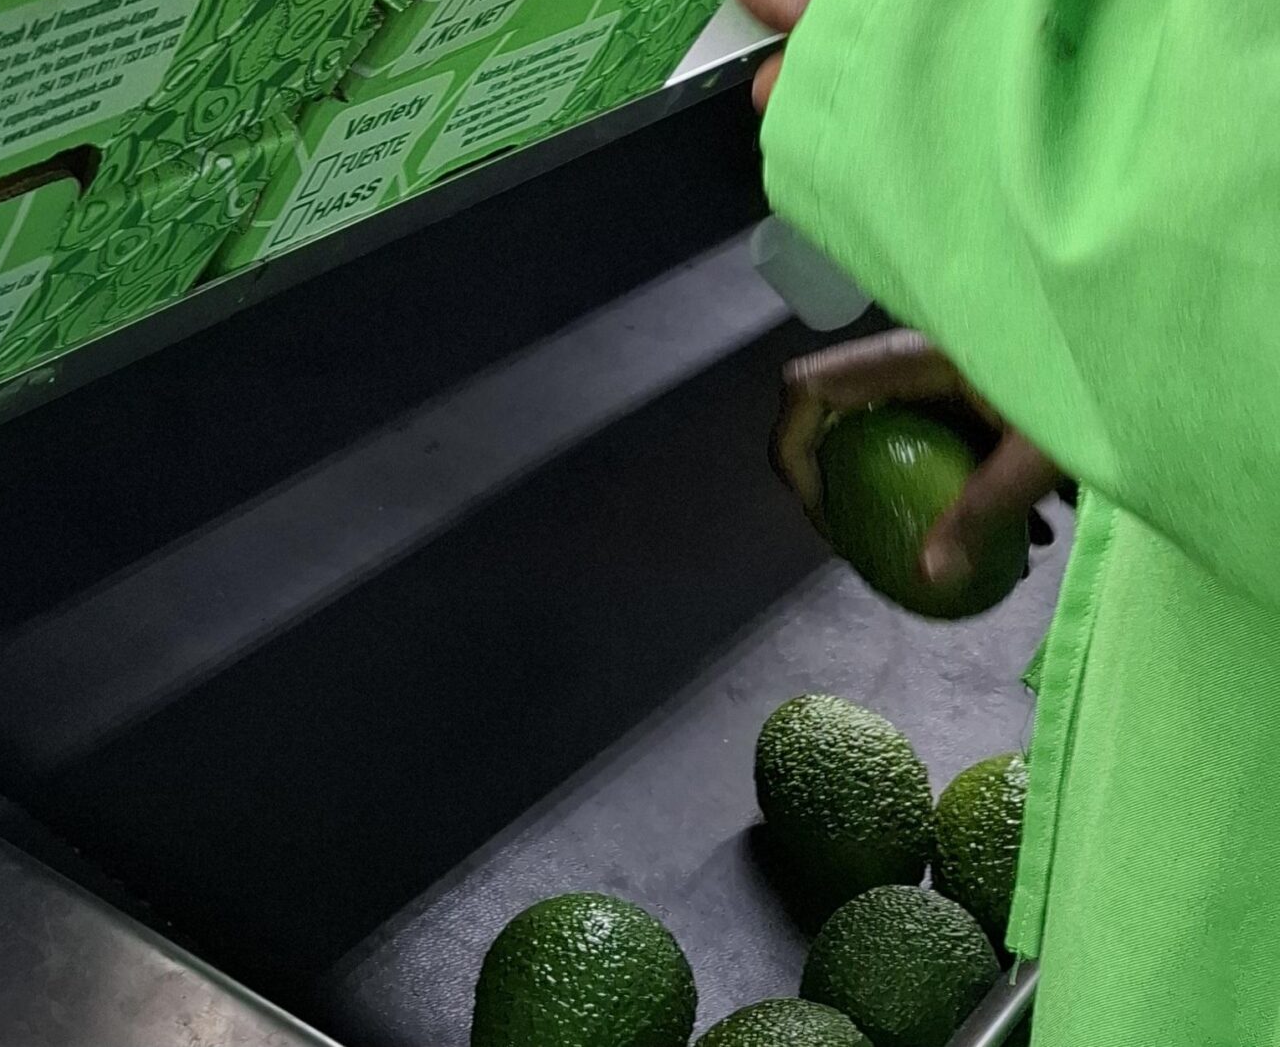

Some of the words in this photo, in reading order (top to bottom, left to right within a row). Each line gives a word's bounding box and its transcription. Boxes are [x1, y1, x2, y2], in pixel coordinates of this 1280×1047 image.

[429, 17, 471, 49] KG
[344, 94, 433, 140] Variety
[333, 132, 412, 178] FUERTE
[306, 177, 383, 225] HASS
